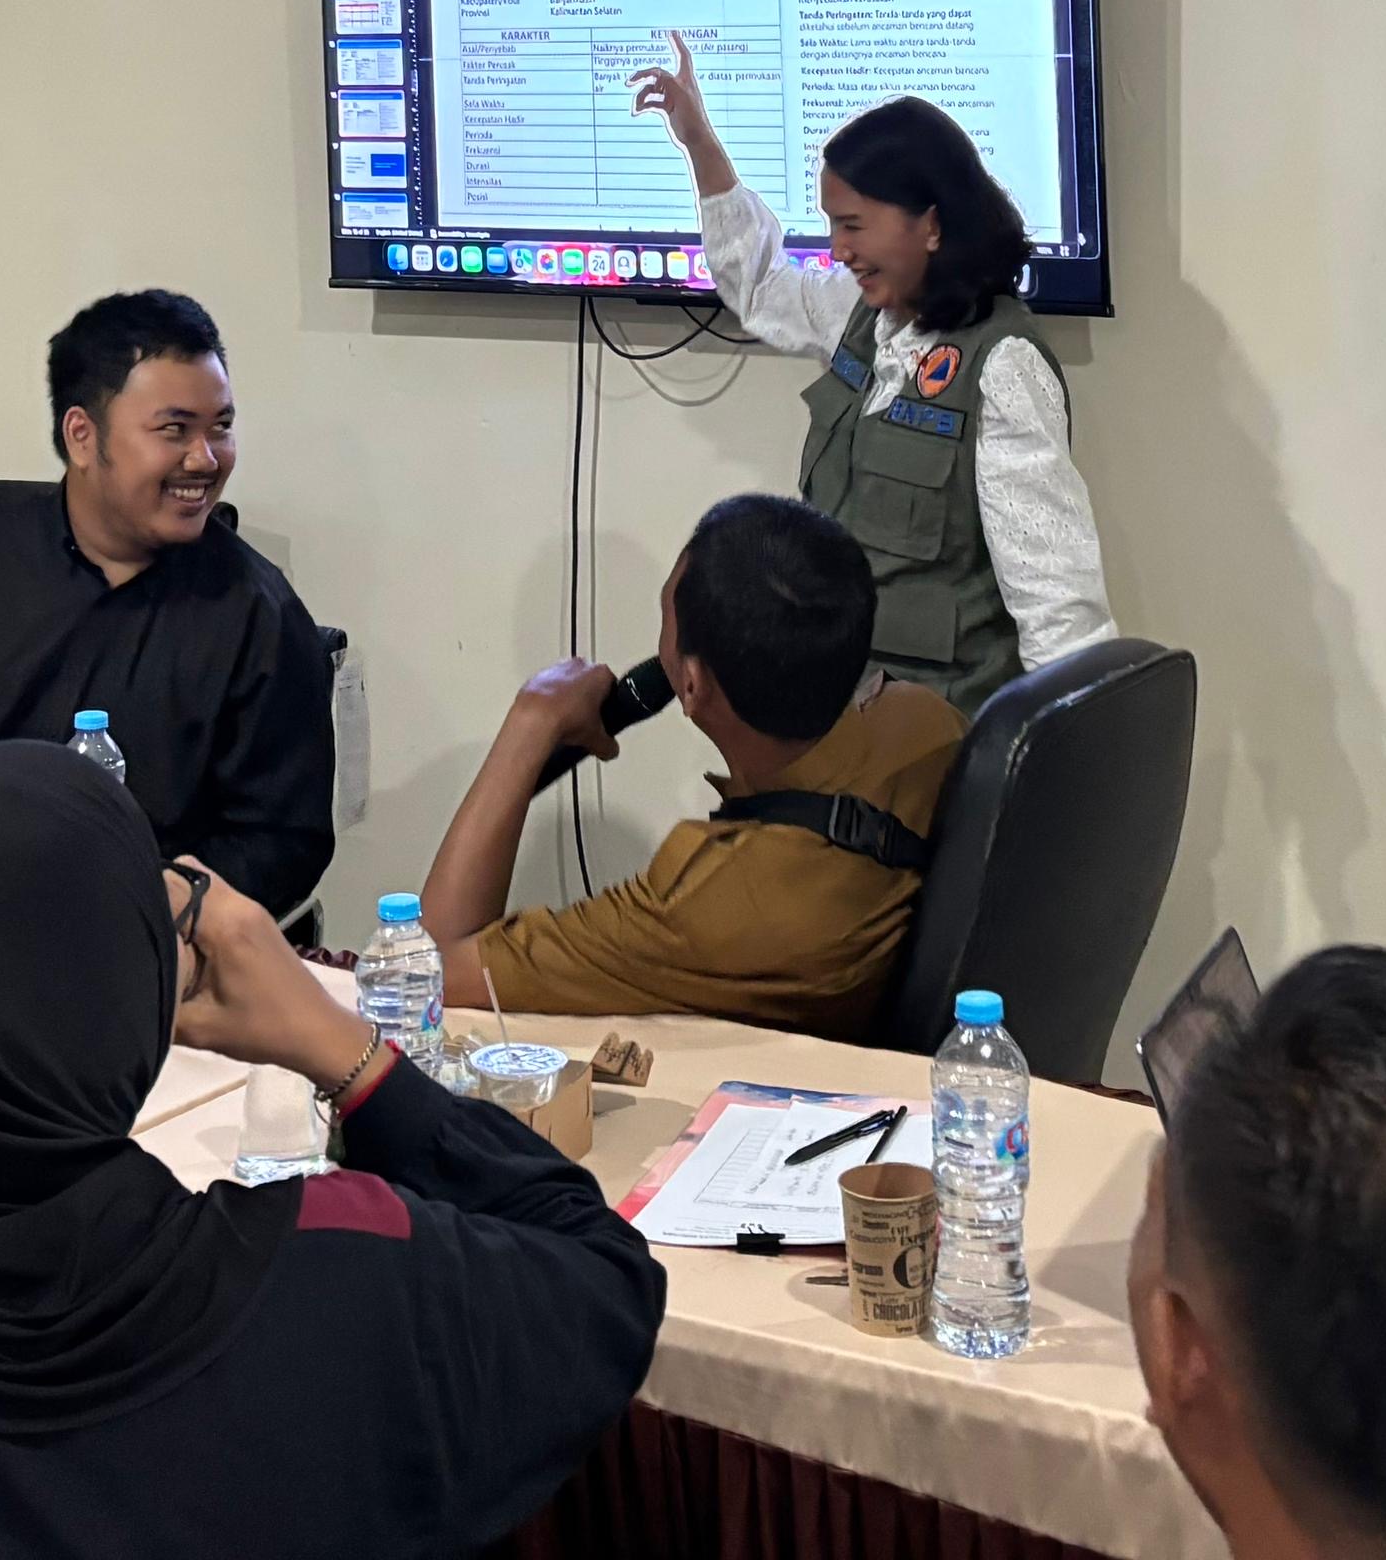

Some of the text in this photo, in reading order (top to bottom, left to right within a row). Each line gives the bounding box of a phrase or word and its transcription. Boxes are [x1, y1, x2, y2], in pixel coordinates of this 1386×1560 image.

[550, 6, 593, 16] Kalimantan
[594, 5, 622, 15] Selatan
[948, 8, 972, 19] dapat
[501, 29, 718, 41] KARAKTER KETANGAN
[716, 43, 749, 53] pasang)
[594, 56, 672, 67] Tingginya genangan
[594, 72, 621, 83] Banyak
[735, 72, 781, 82] permukaan
[464, 115, 503, 125] Kecepatan
[592, 259, 605, 272] 24
[890, 397, 954, 435] BNPB
